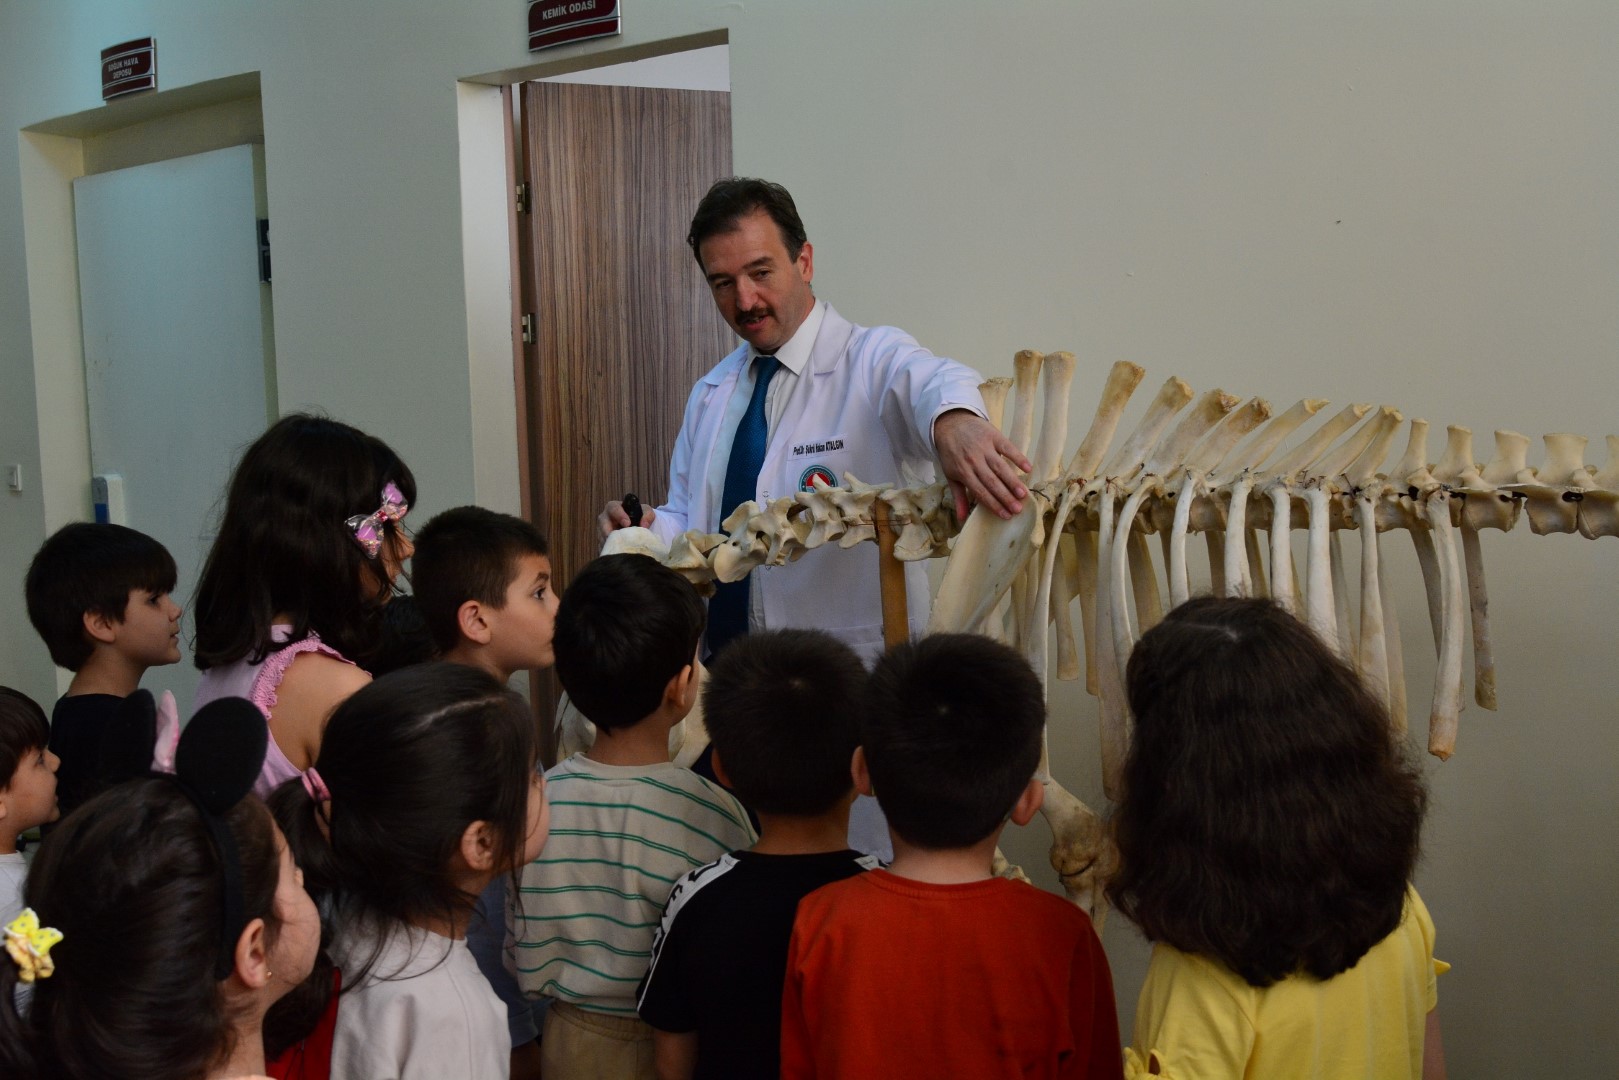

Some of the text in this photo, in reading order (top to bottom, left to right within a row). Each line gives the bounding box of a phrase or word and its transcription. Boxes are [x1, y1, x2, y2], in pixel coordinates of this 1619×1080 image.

[542, 0, 596, 20] KEMİK ODASI
[124, 57, 139, 67] HAVA
